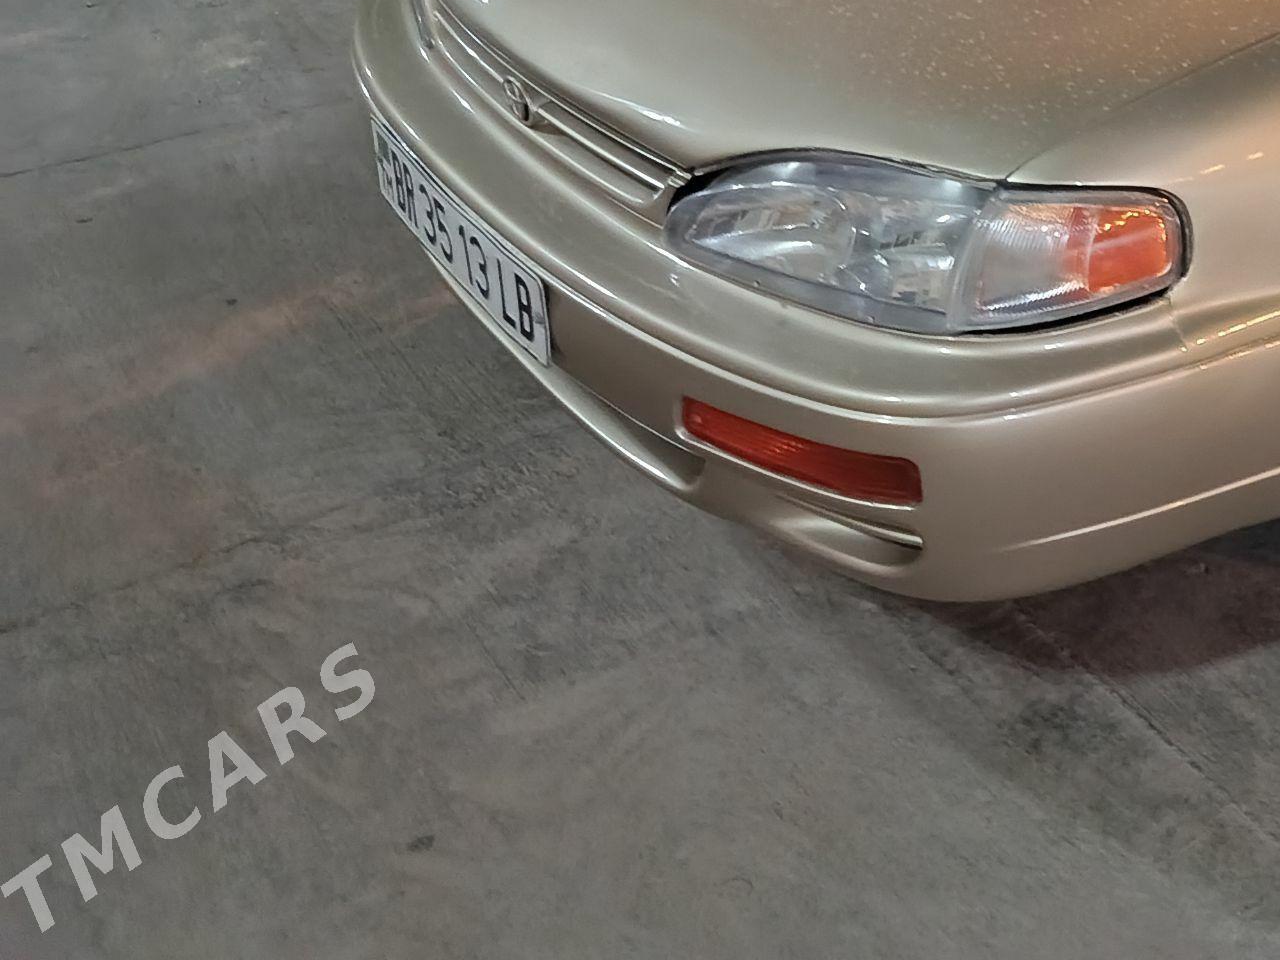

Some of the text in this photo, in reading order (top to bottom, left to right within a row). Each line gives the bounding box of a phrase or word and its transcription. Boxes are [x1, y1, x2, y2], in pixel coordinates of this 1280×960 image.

[420, 184, 454, 263] 35
[458, 224, 490, 300] 13
[497, 257, 536, 342] LB
